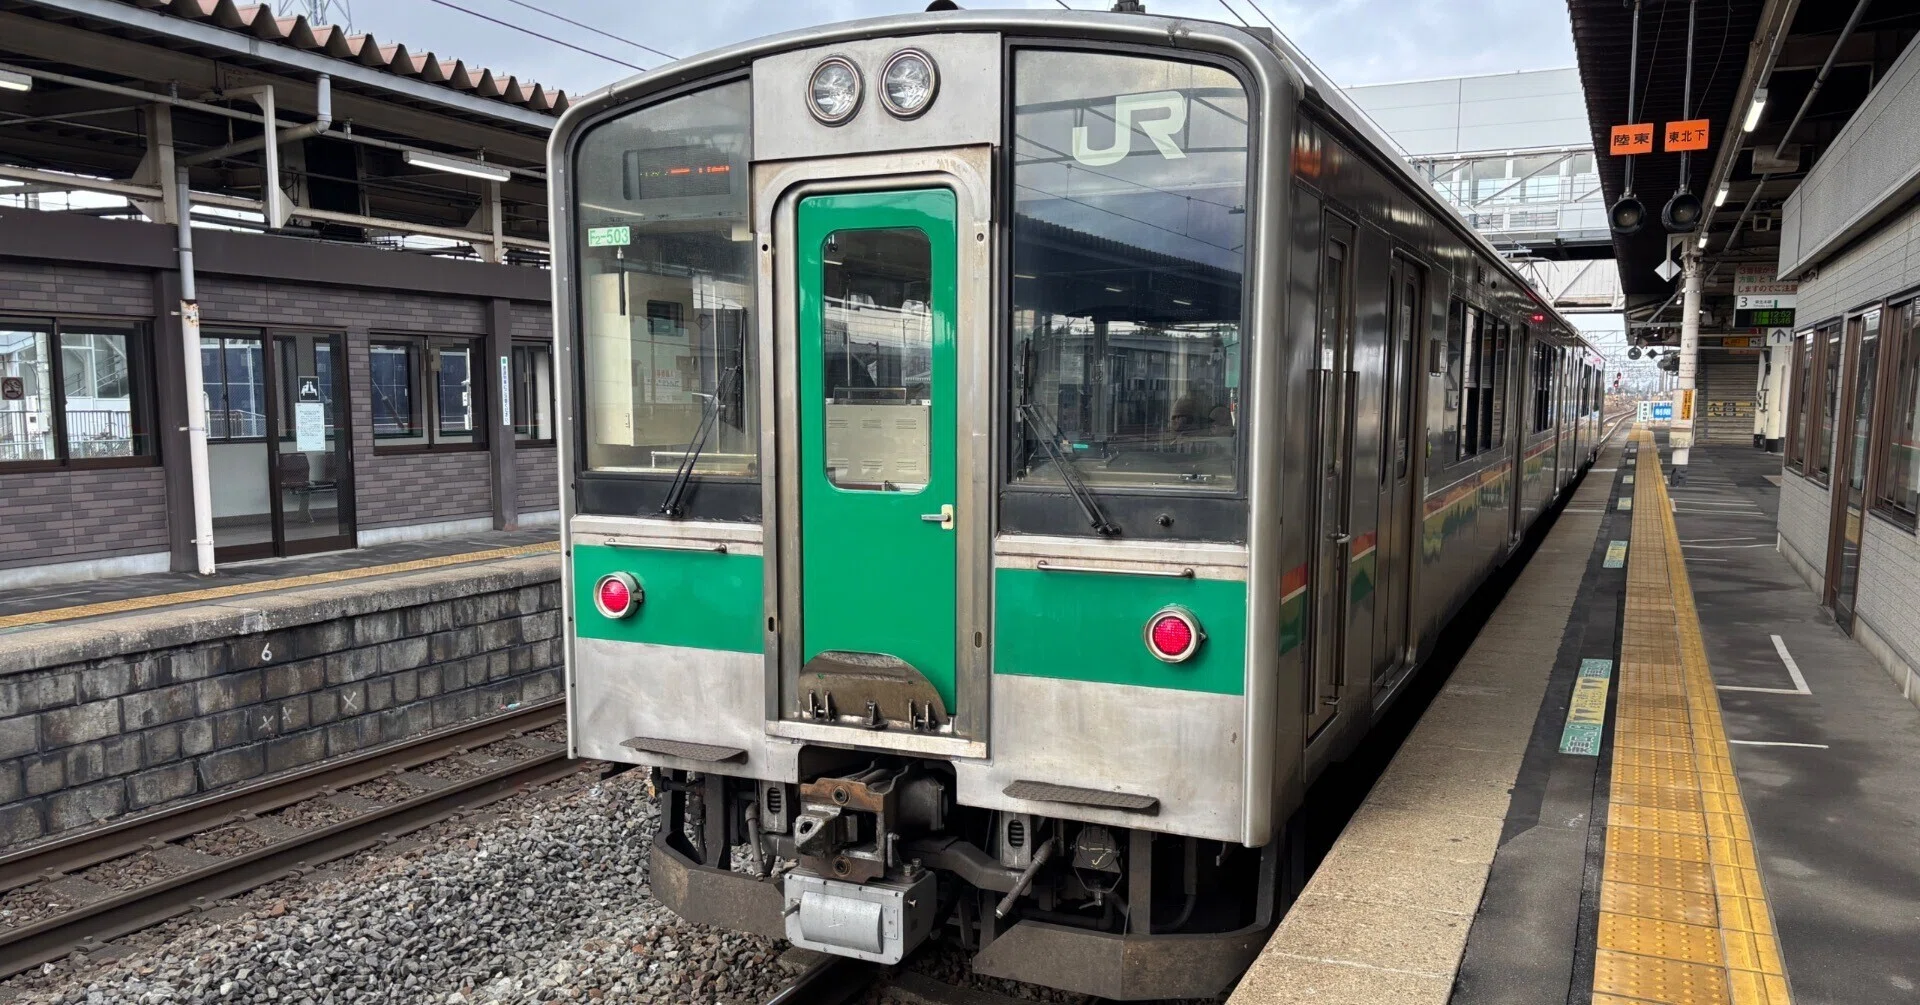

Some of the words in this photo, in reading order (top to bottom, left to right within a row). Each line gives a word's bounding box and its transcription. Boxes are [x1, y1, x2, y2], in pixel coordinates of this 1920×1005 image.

[1072, 90, 1187, 166] JR
[1613, 132, 1650, 146] 陸東
[1668, 129, 1706, 143] 東北下
[1740, 297, 1748, 307] 3
[261, 642, 273, 661] 6
